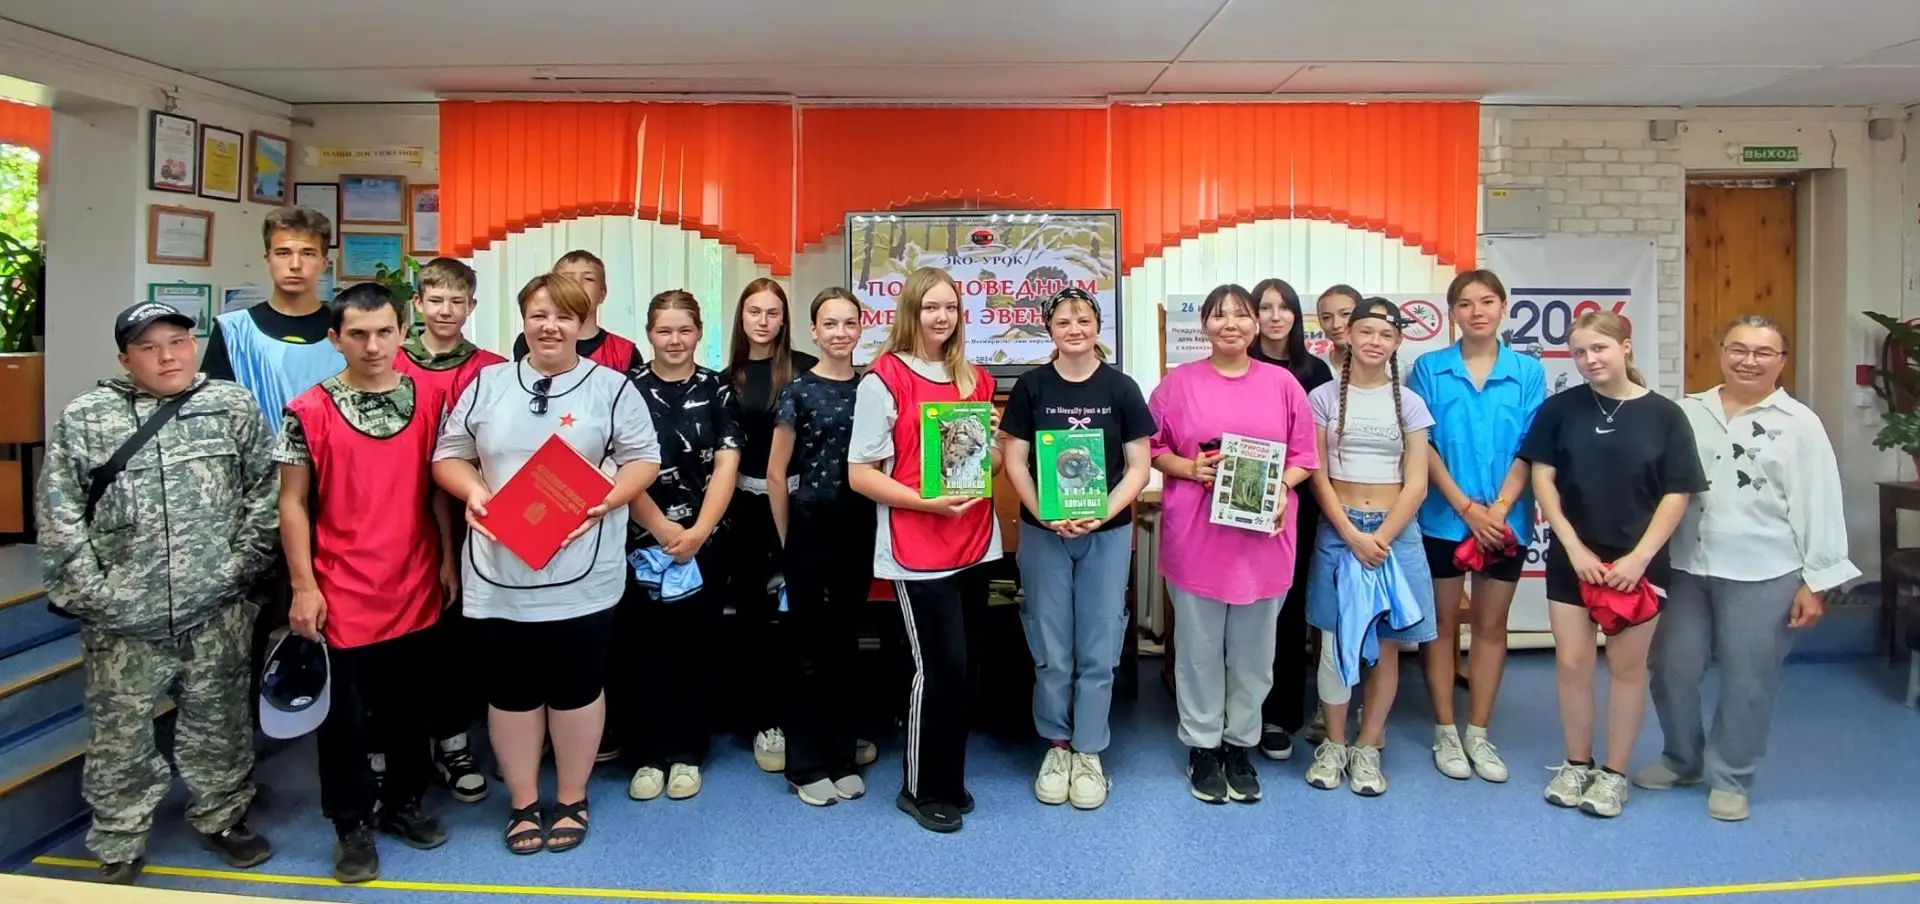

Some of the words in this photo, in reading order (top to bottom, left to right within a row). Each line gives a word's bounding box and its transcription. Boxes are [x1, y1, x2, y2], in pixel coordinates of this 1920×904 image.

[1743, 149, 1797, 160] ВЫХОД
[868, 281, 904, 297] ПО
[1182, 303, 1194, 312] 26
[1057, 406, 1082, 415] literally
